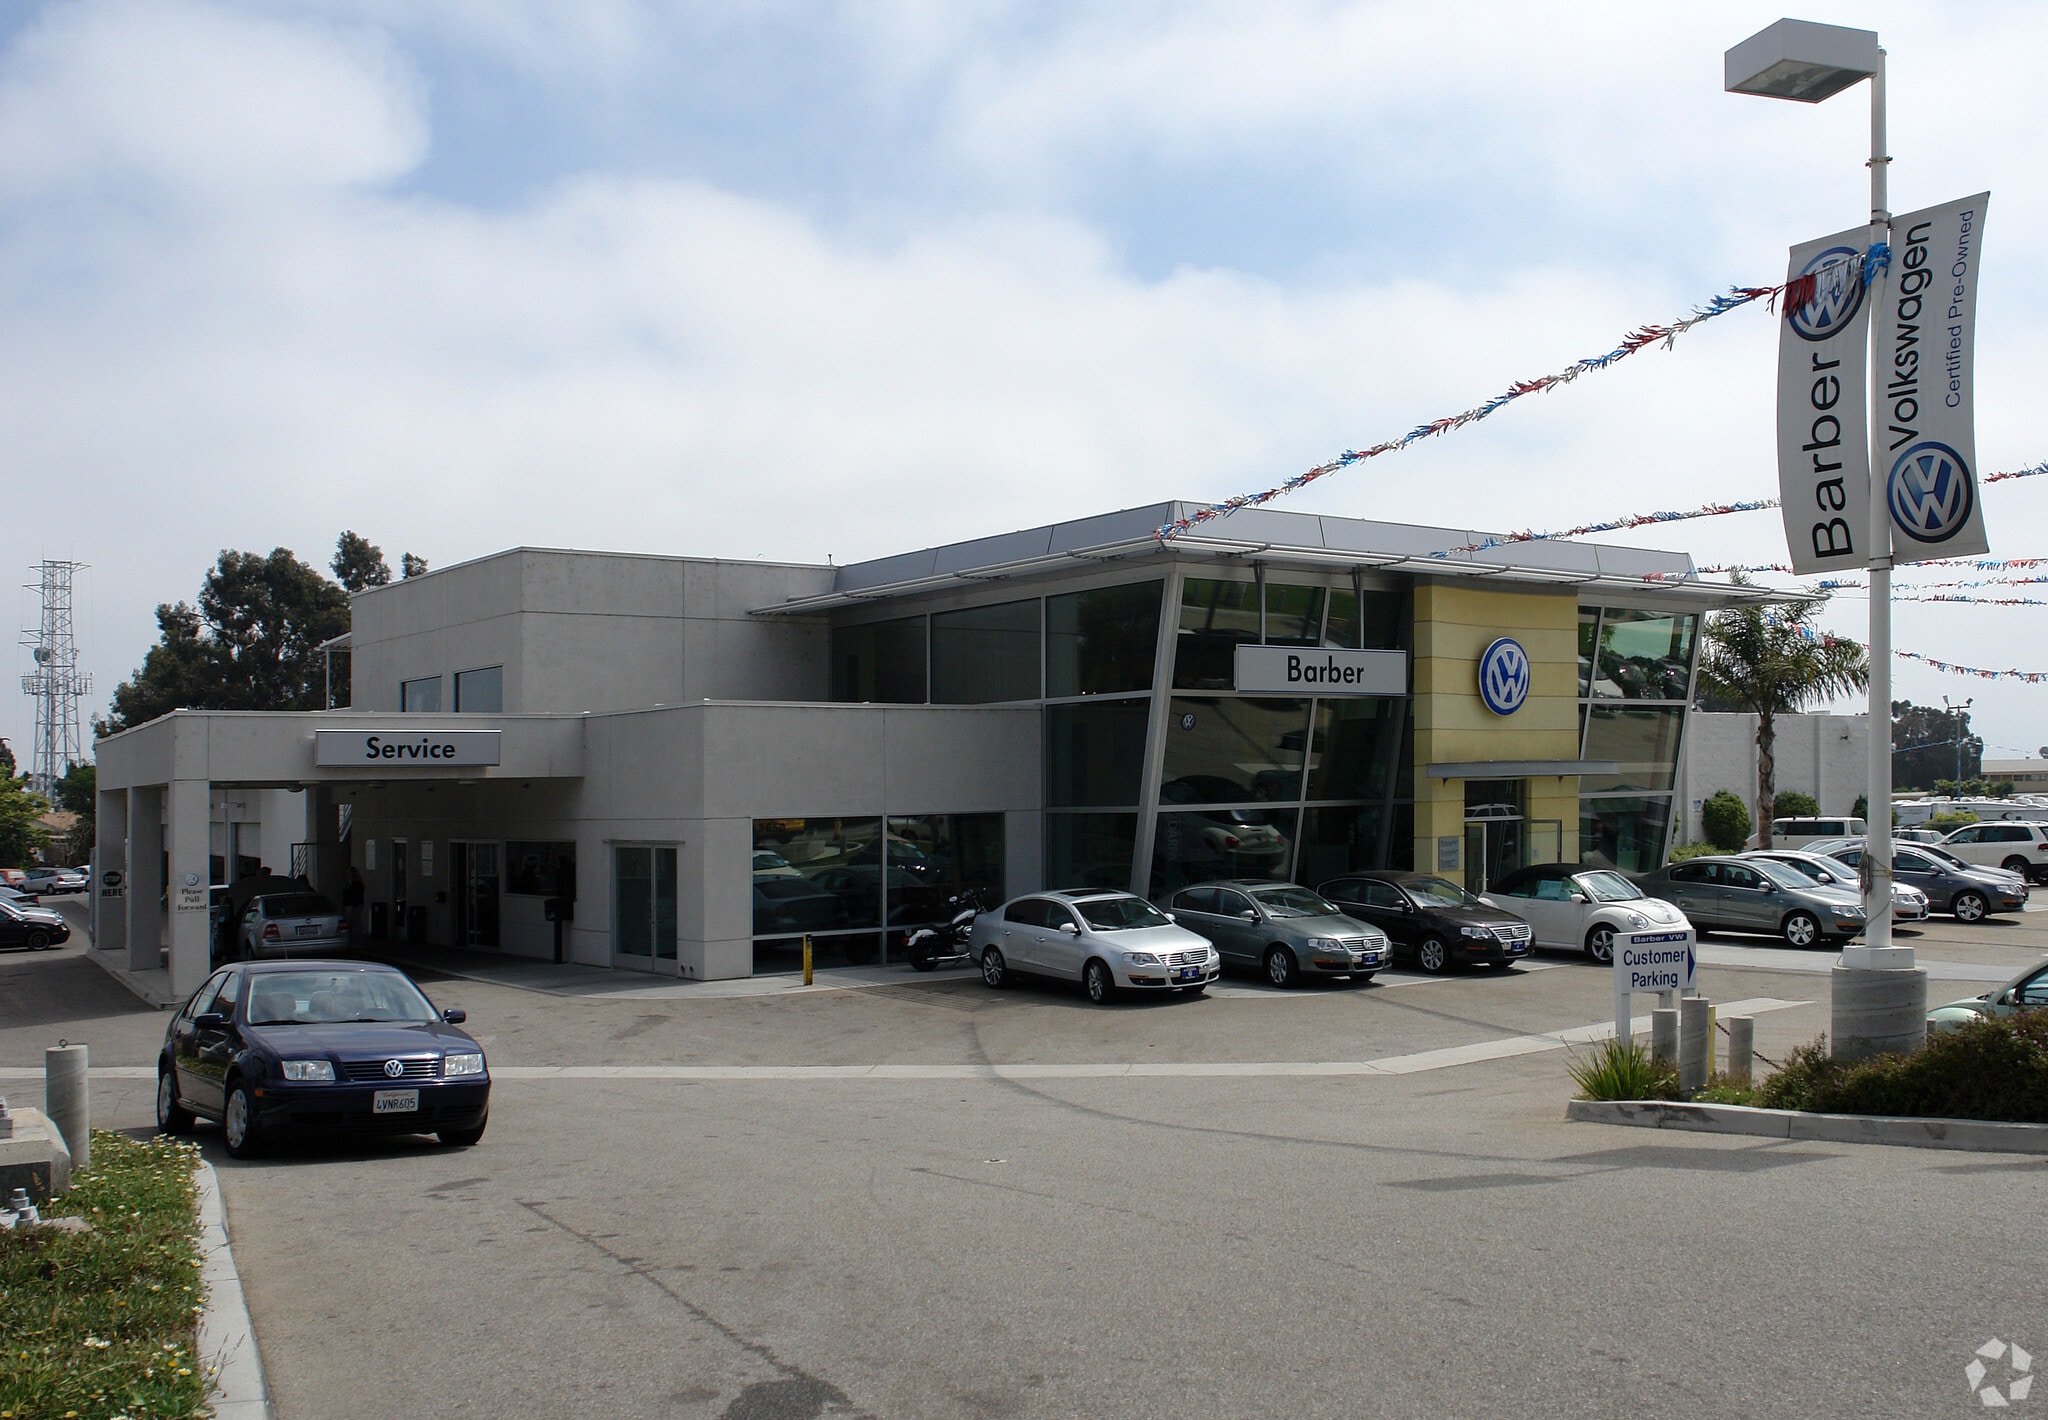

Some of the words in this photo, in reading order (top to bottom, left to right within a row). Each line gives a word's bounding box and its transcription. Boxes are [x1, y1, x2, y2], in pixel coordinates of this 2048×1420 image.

[1948, 209, 1974, 319] Pre-Owned
[1887, 220, 1932, 452] Volkswagen
[1945, 325, 1962, 408] Certified
[1801, 352, 1854, 558] Barber
[1287, 654, 1365, 684] Barber
[365, 736, 456, 759] Service
[103, 875, 122, 884] STOP
[102, 888, 123, 897] HERE
[177, 903, 207, 911] Forward
[1633, 935, 1665, 943] Barber
[1668, 933, 1685, 941] VW
[1623, 949, 1686, 966] Customer
[1631, 970, 1678, 988] Parking
